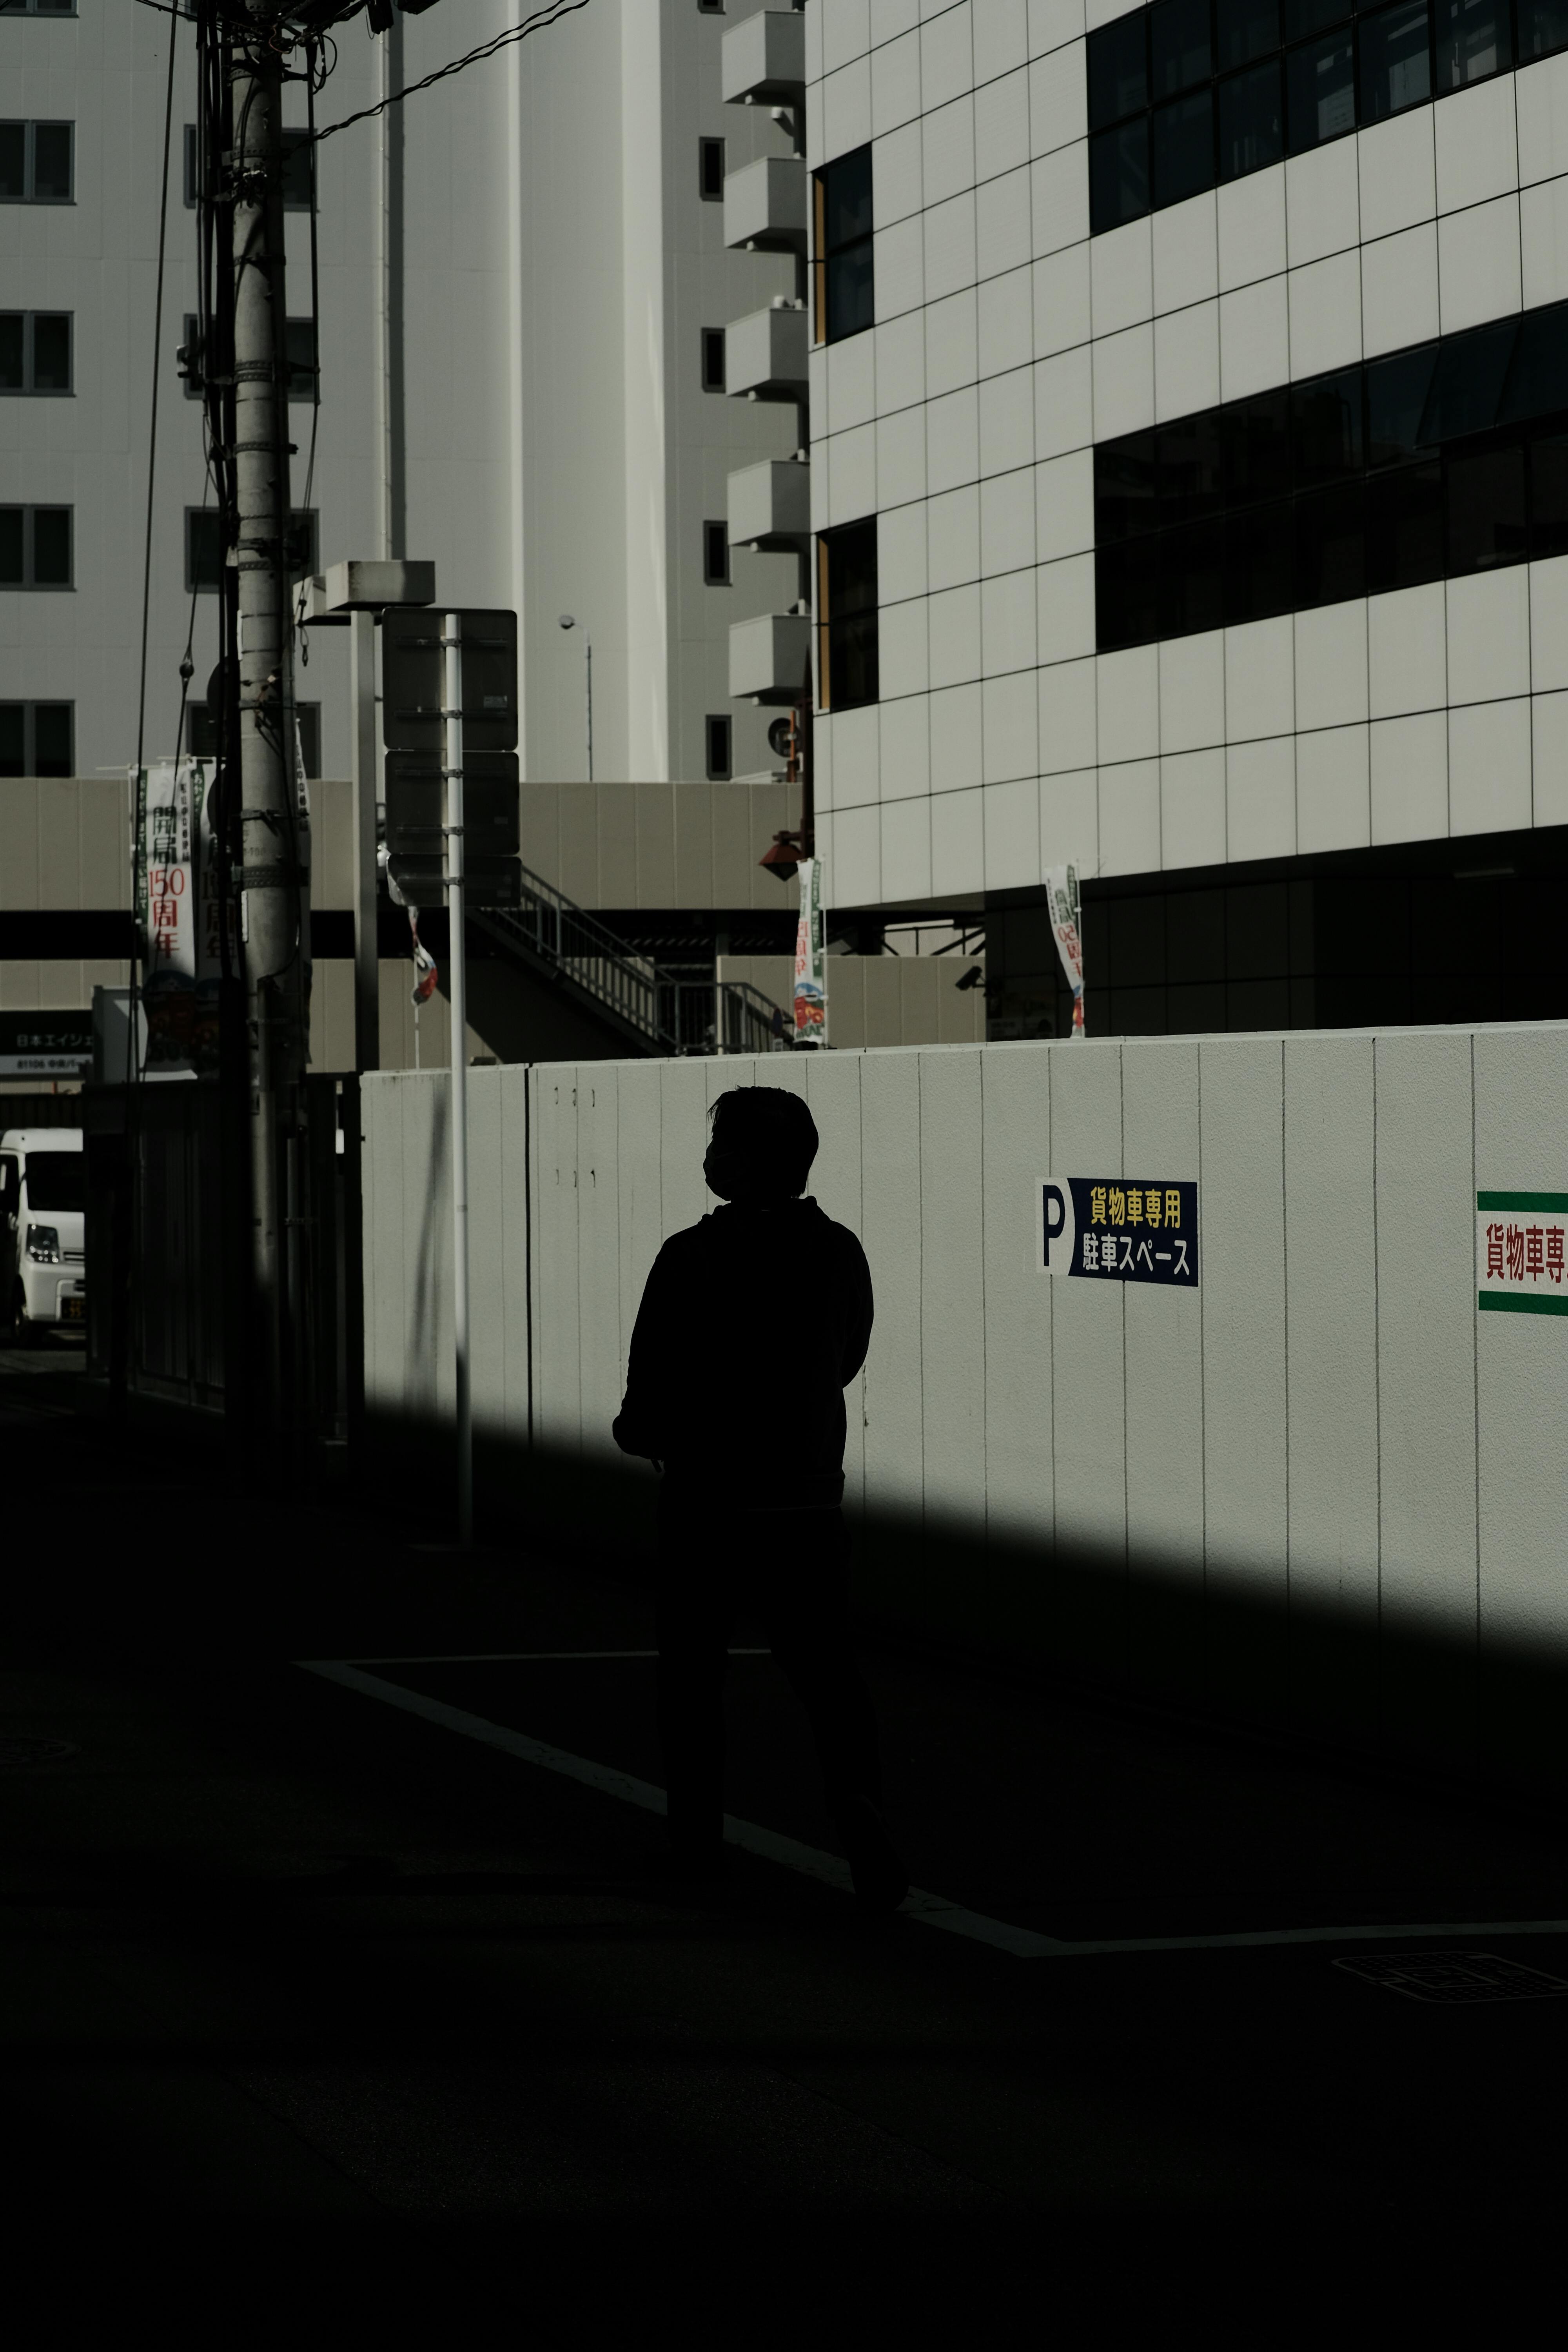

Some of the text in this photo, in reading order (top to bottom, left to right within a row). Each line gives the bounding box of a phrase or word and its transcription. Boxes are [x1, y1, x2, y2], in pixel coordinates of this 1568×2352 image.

[1042, 1185, 1065, 1267] P
[1090, 1186, 1181, 1229] 貨物車専用
[1083, 1232, 1190, 1276] 駐車スペース
[1486, 1223, 1568, 1283] 貨物車専
